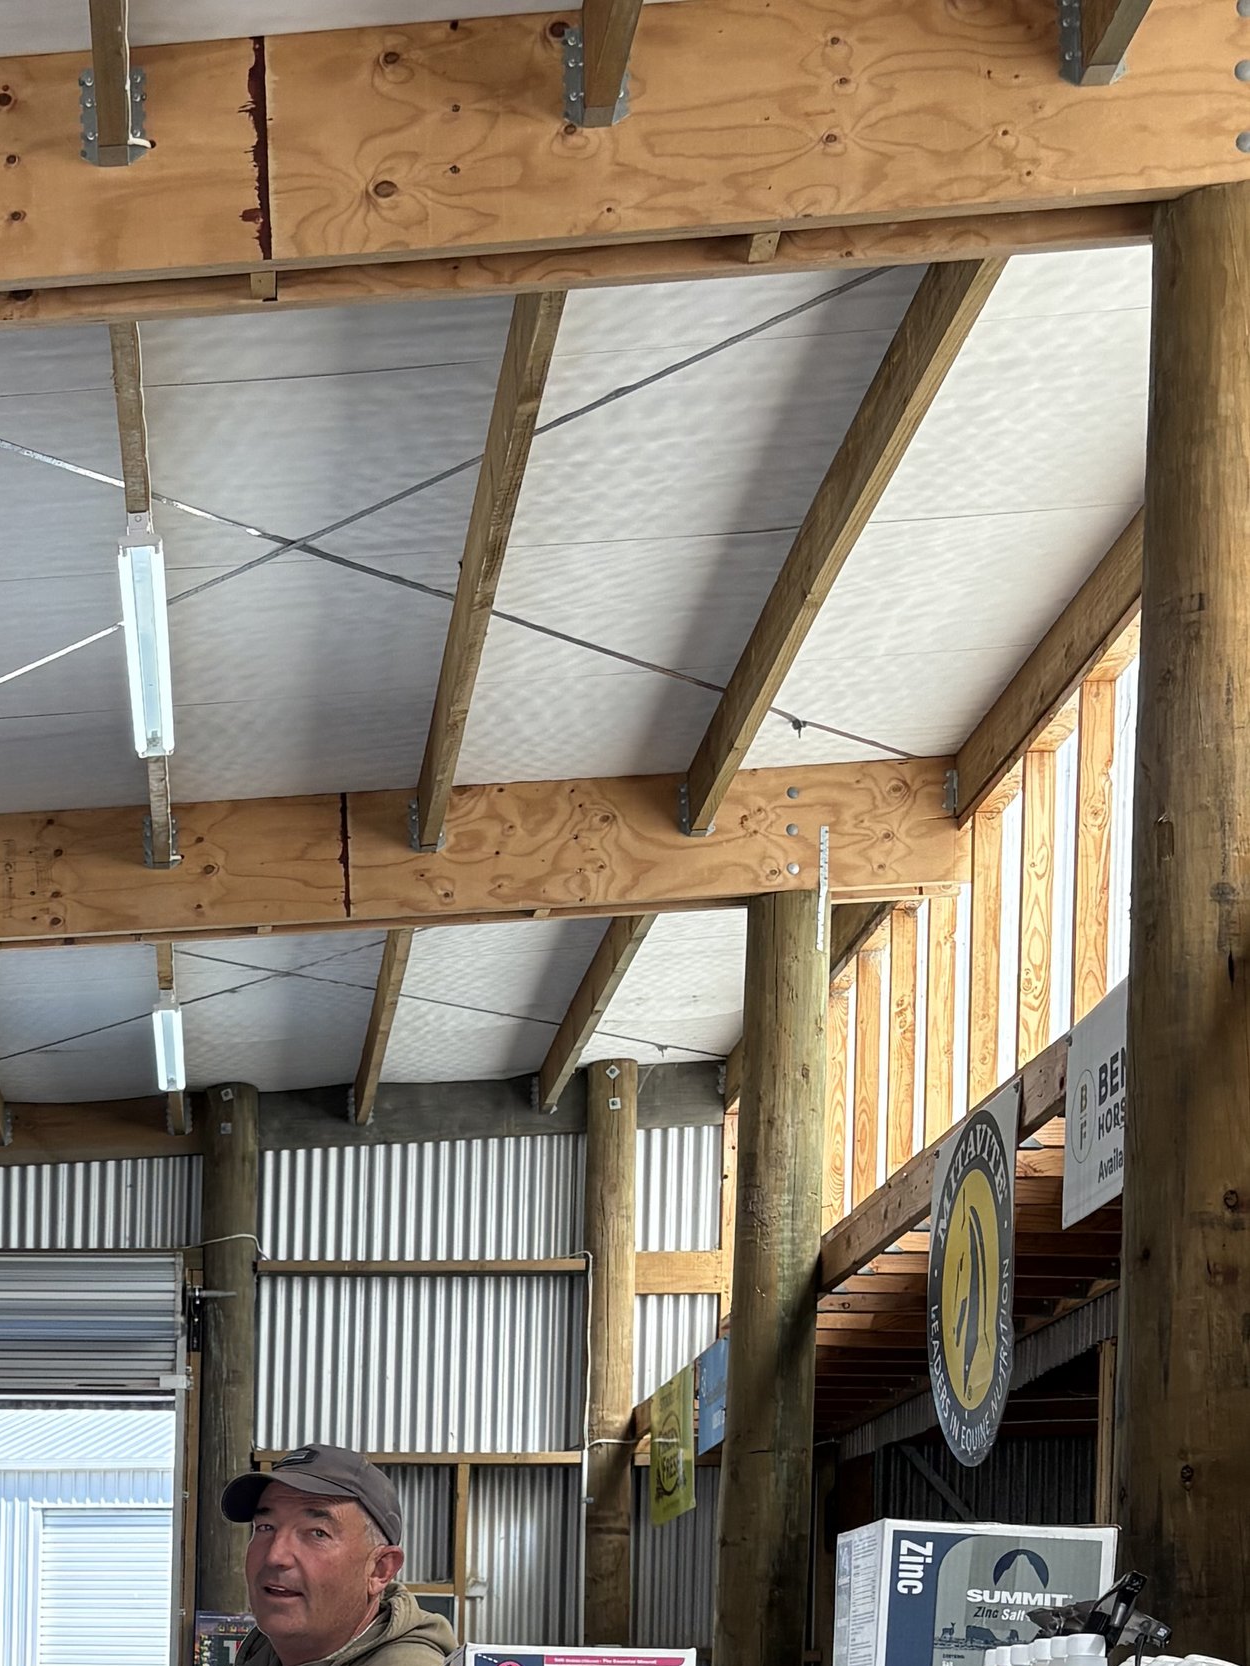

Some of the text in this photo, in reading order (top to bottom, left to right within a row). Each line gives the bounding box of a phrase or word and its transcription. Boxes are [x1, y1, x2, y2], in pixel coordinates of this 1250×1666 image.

[937, 1124, 1008, 1248] MITAVITE
[930, 1258, 1010, 1455] LEADERS IN EQUINE NUTRITION
[897, 1539, 934, 1594] Zinc
[966, 1589, 1069, 1607] SUMMIT
[974, 1607, 1025, 1621] Zinc Salt
